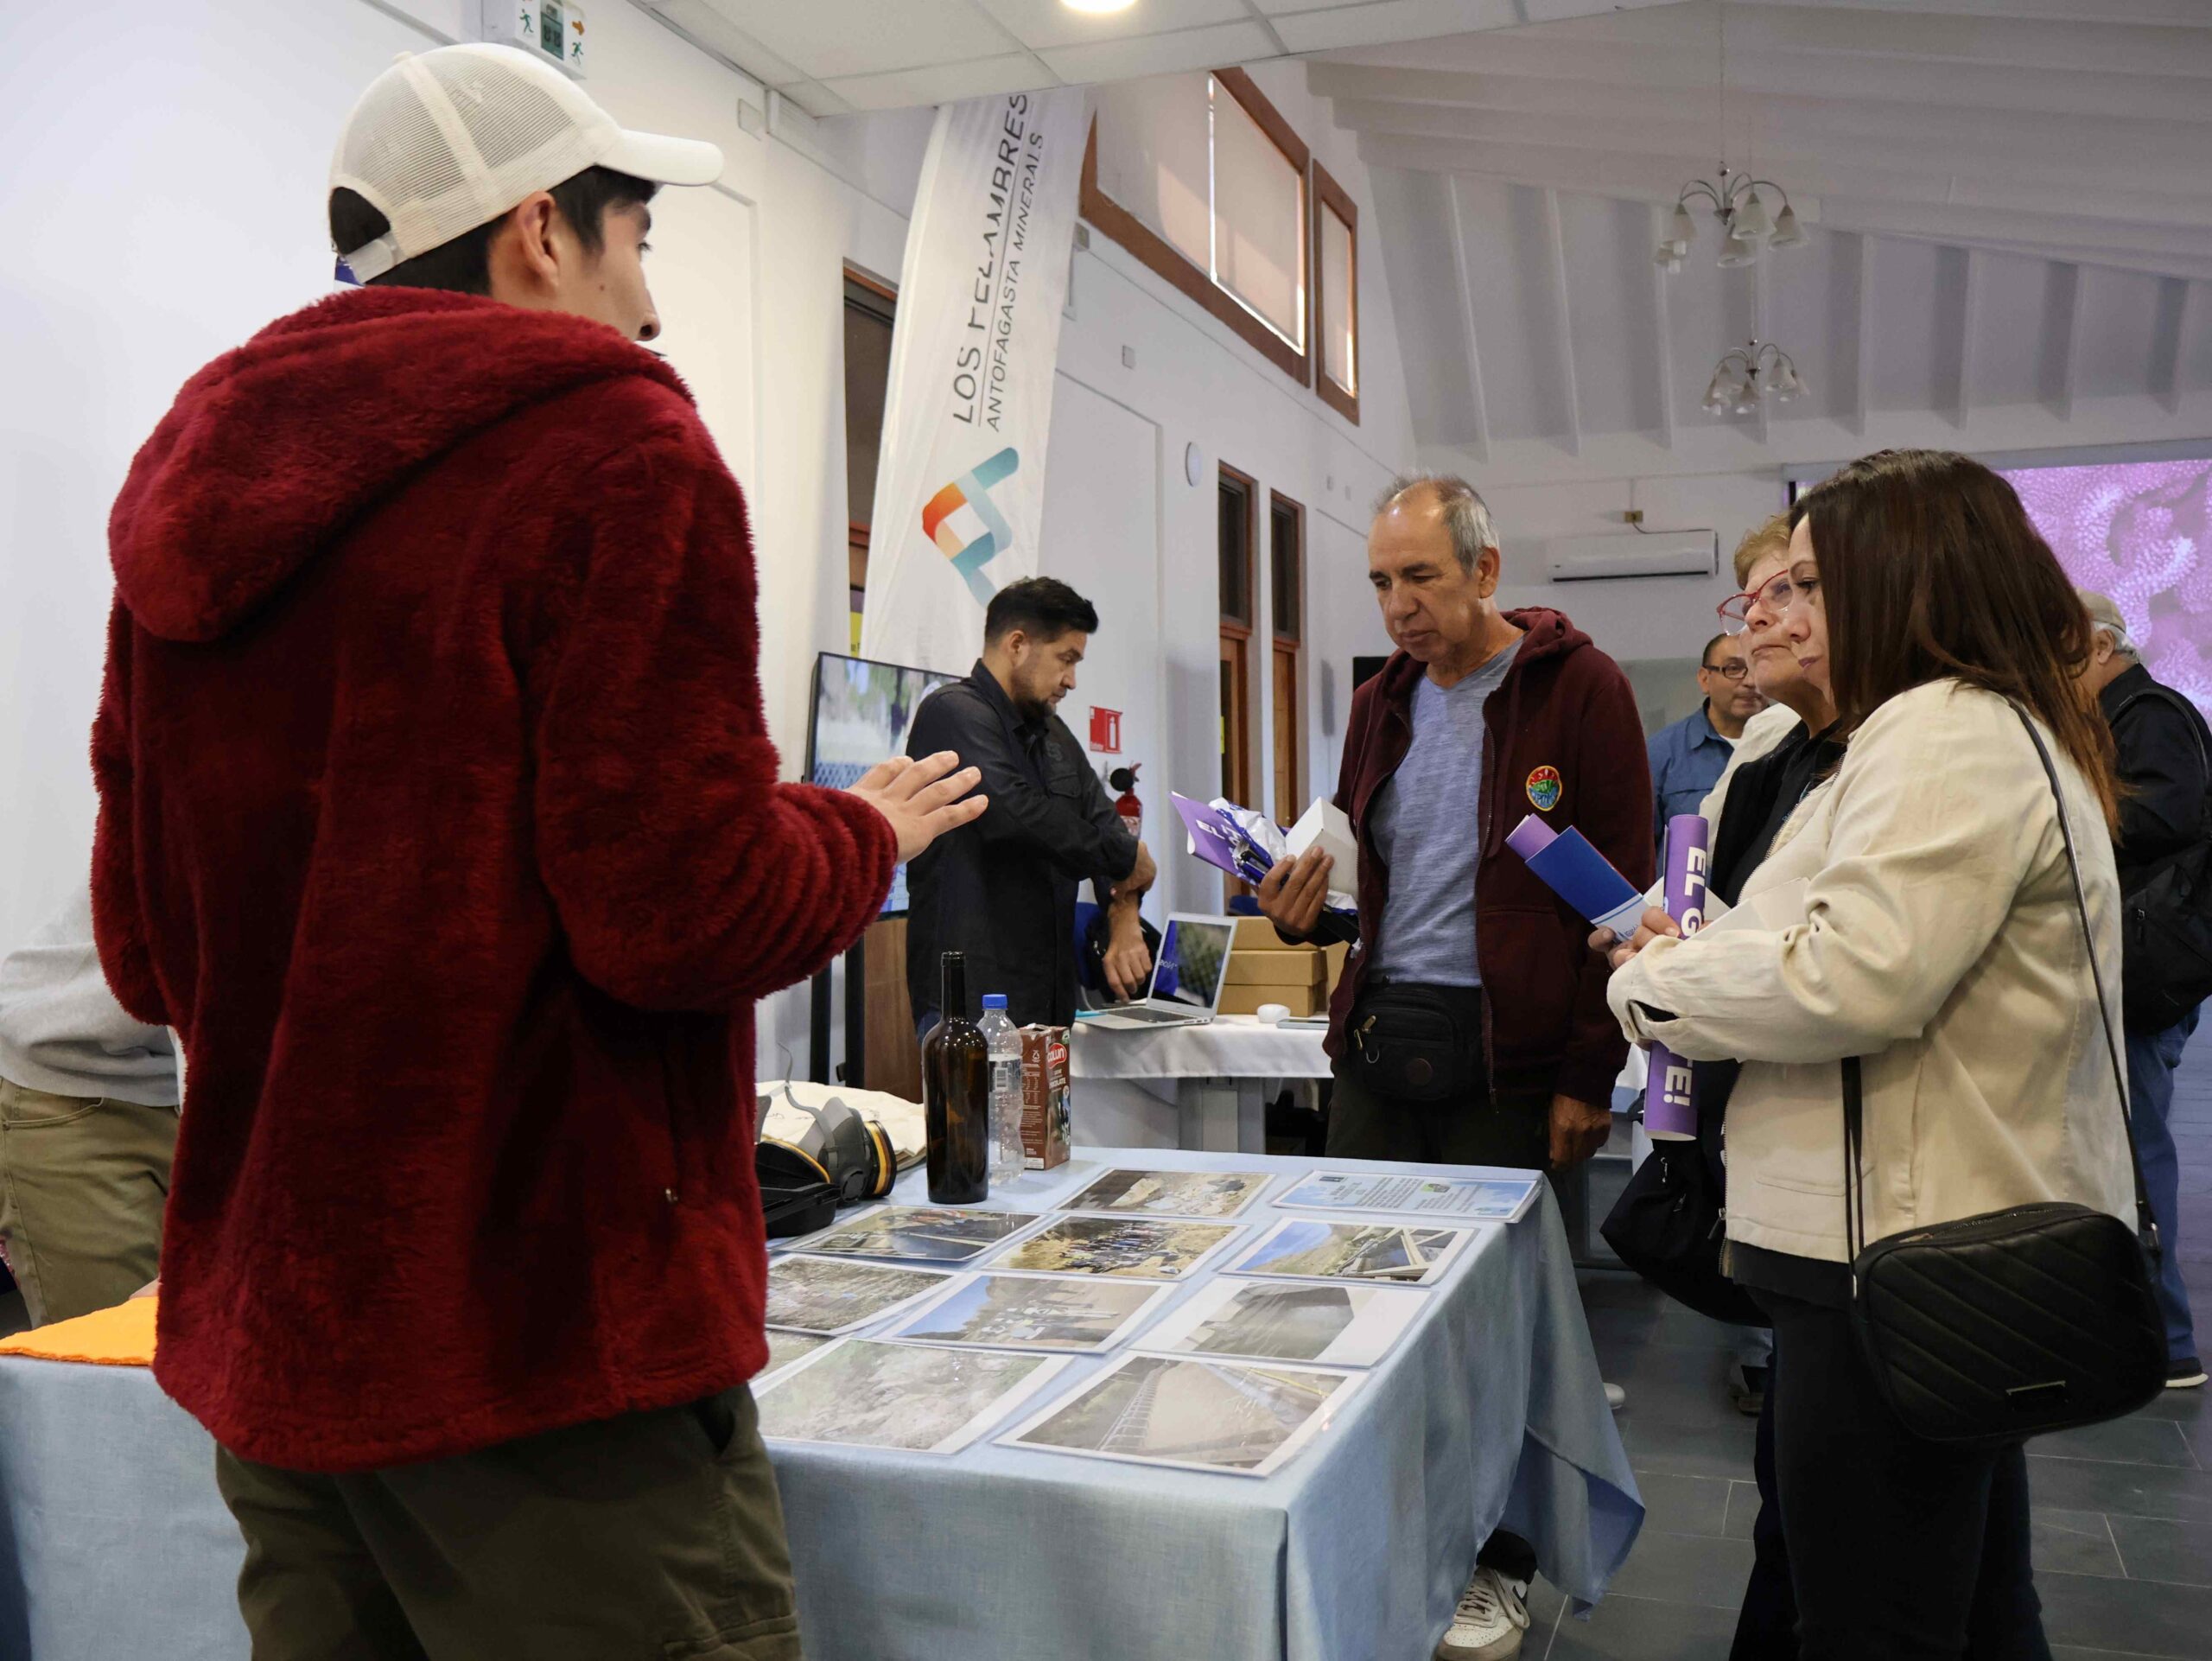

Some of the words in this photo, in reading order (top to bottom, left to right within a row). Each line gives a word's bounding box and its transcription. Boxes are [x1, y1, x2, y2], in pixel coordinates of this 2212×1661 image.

[986, 260, 1021, 433] ANTOFAGASTA
[1013, 132, 1044, 251] MINERALS
[953, 347, 982, 423] LOS
[1684, 846, 1707, 897] EL
